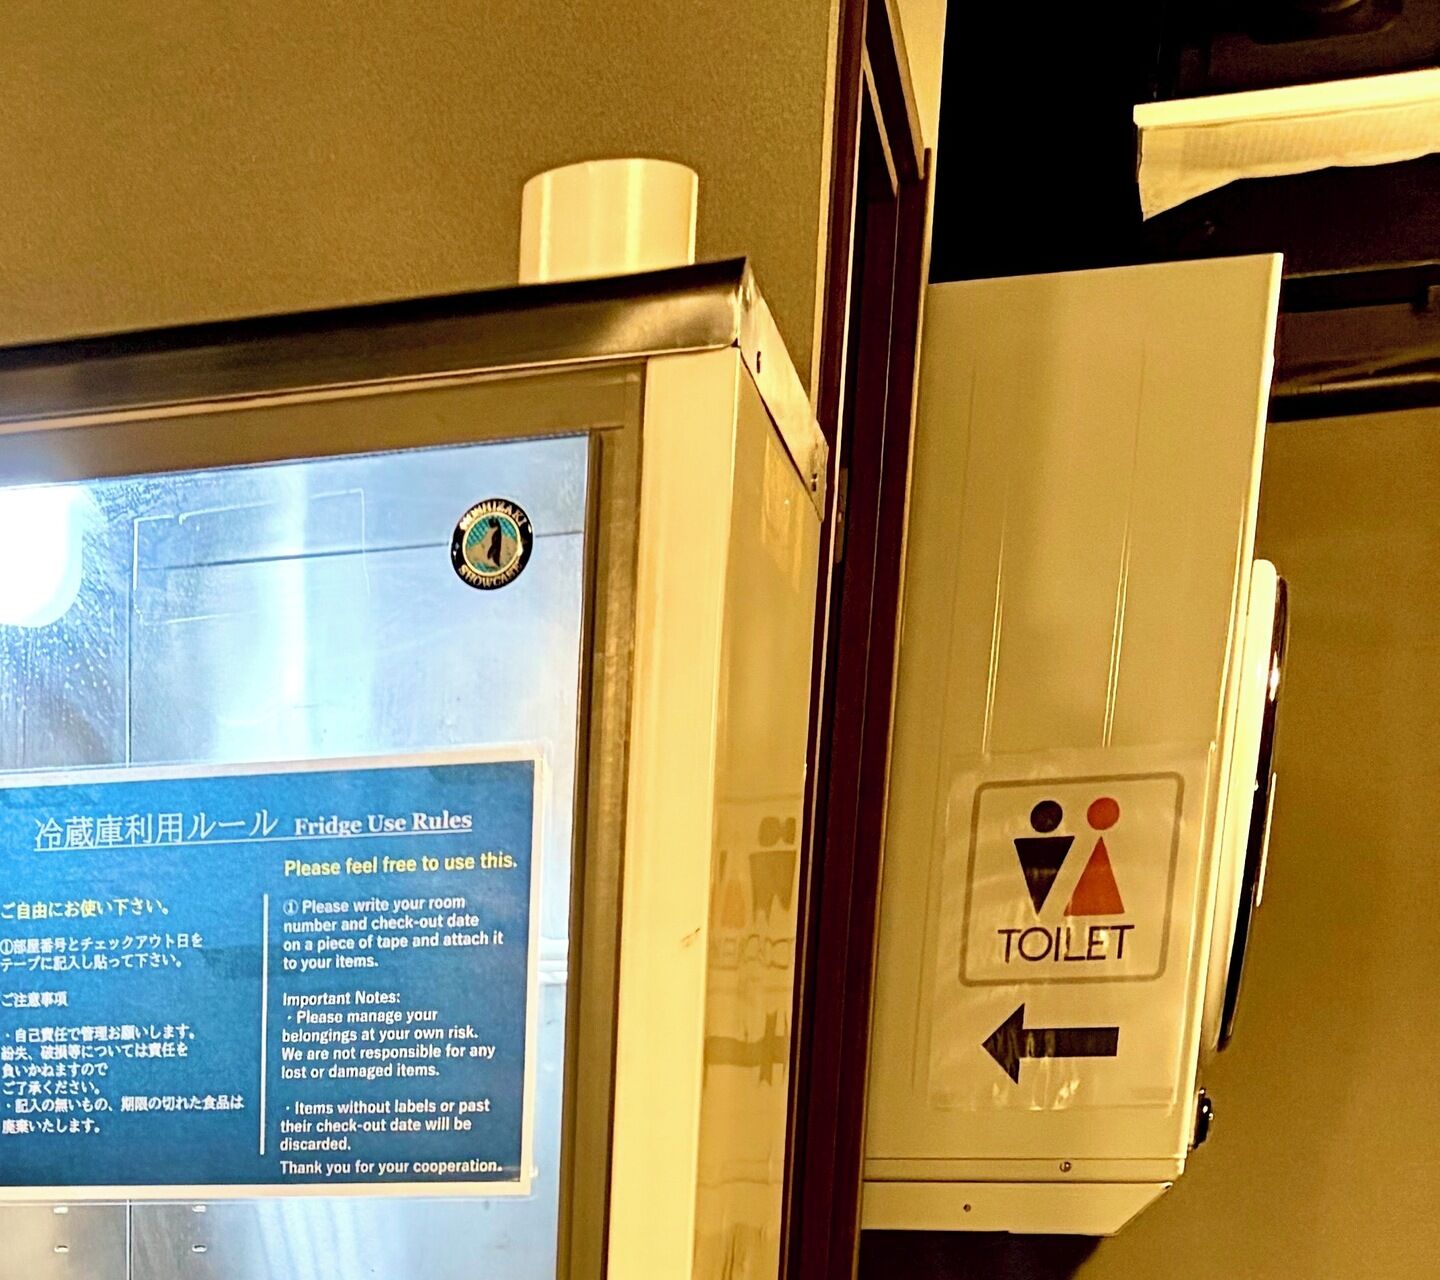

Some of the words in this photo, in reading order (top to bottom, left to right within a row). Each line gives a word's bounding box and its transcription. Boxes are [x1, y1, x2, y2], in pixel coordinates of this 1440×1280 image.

[34, 808, 280, 848] 冷蔵庫利用ルール
[293, 816, 362, 838] Fridge
[367, 814, 408, 833] Use
[411, 810, 473, 831] Rules
[284, 859, 341, 876] Please
[345, 856, 378, 874] feel
[382, 855, 417, 872] free
[421, 855, 439, 871] to
[444, 856, 475, 871] use
[479, 850, 517, 869] this.
[301, 899, 349, 914] Please
[352, 896, 389, 912] write
[392, 898, 426, 914] your
[428, 896, 466, 910] room
[283, 917, 337, 933] number
[340, 915, 367, 931] and
[370, 913, 444, 930] check-out
[446, 912, 480, 928] date
[282, 940, 301, 951] on
[304, 939, 313, 951] a
[316, 935, 355, 953] piece
[358, 933, 373, 949] of
[376, 934, 408, 950] tape
[411, 931, 439, 948] and
[442, 930, 489, 947] attach
[492, 929, 504, 945] it
[997, 924, 1135, 963] TOILET
[282, 956, 297, 970] to
[300, 957, 332, 972] your
[335, 953, 378, 968] items.
[282, 991, 351, 1008] Important
[354, 990, 400, 1005] Notes:
[296, 1009, 343, 1024] Please
[346, 1010, 402, 1025] manage
[405, 1010, 438, 1024] your
[281, 1028, 357, 1044] belongings
[360, 1027, 375, 1041] at
[378, 1029, 410, 1043] your
[413, 1028, 444, 1040] own
[448, 1024, 478, 1039] risk.
[281, 1046, 303, 1061] We
[306, 1049, 329, 1060] are
[332, 1046, 356, 1060] not
[359, 1043, 441, 1061] responsible
[444, 1043, 466, 1058] for
[468, 1045, 496, 1059] any
[281, 1064, 307, 1079] lost
[309, 1067, 325, 1078] or
[327, 1062, 393, 1080] damaged
[396, 1062, 440, 1077] items.
[294, 1100, 333, 1115] Items
[336, 1099, 391, 1114] without
[394, 1098, 436, 1113] labels
[439, 1101, 455, 1112] or
[458, 1098, 490, 1115] past
[280, 1118, 312, 1133] their
[315, 1117, 386, 1133] check-out
[389, 1116, 422, 1131] date
[424, 1115, 450, 1131] will
[453, 1115, 472, 1131] be
[279, 1135, 351, 1151] discarded.
[279, 1159, 322, 1174] Thank
[325, 1163, 351, 1176] you
[354, 1159, 375, 1173] for
[377, 1161, 409, 1176] your
[412, 1157, 503, 1175] cooperation.
